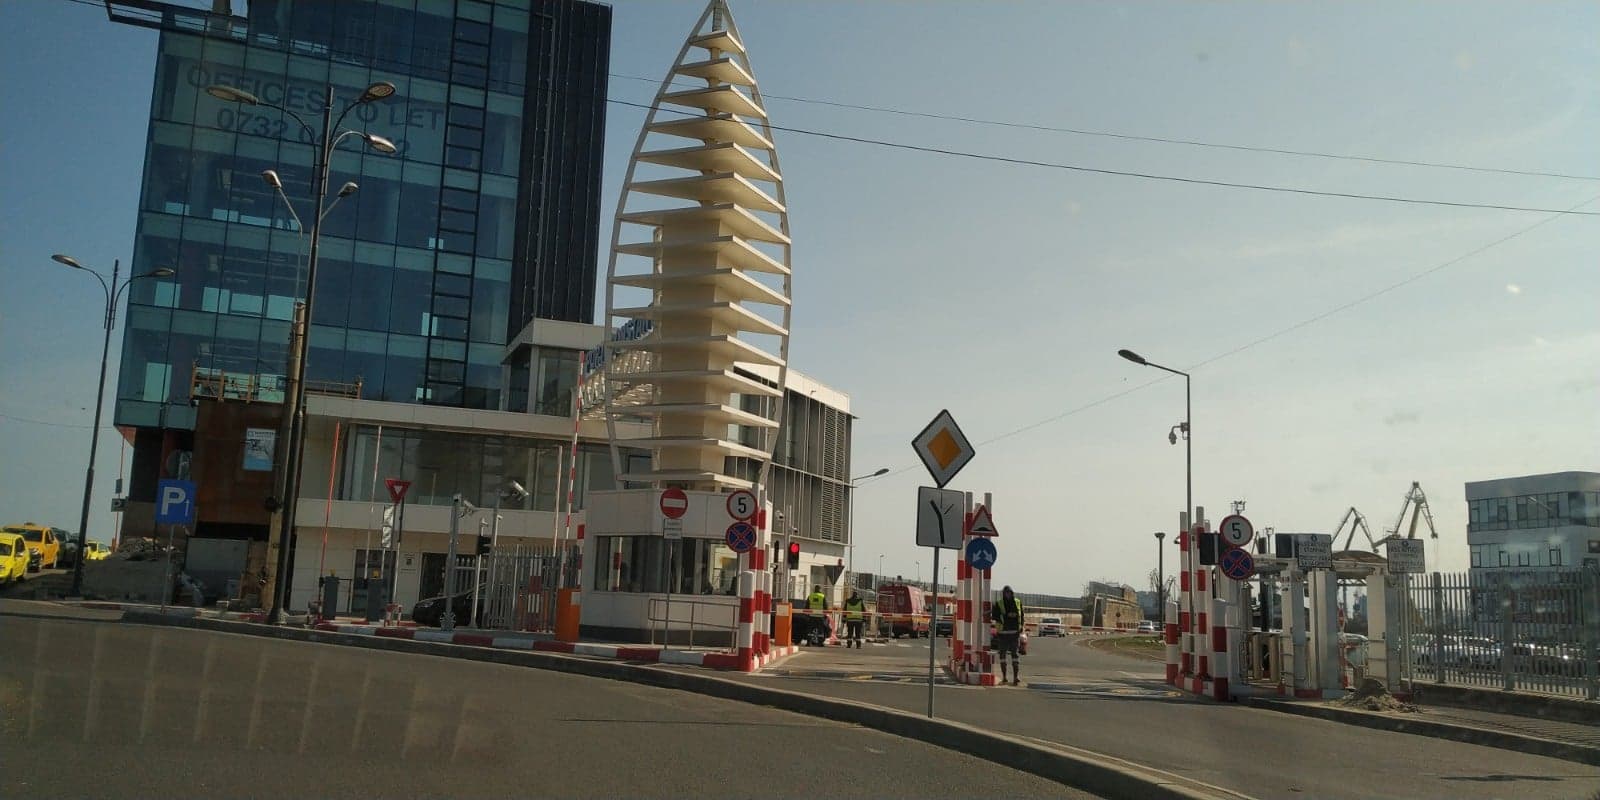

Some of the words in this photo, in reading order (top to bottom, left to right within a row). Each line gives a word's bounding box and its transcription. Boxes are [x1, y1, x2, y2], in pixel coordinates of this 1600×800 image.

[187, 65, 325, 114] OFFICES
[334, 94, 379, 123] TO
[389, 102, 445, 131] LET
[217, 108, 288, 139] 0732
[161, 487, 186, 515] P
[737, 497, 747, 514] 5
[1231, 522, 1241, 540] 5
